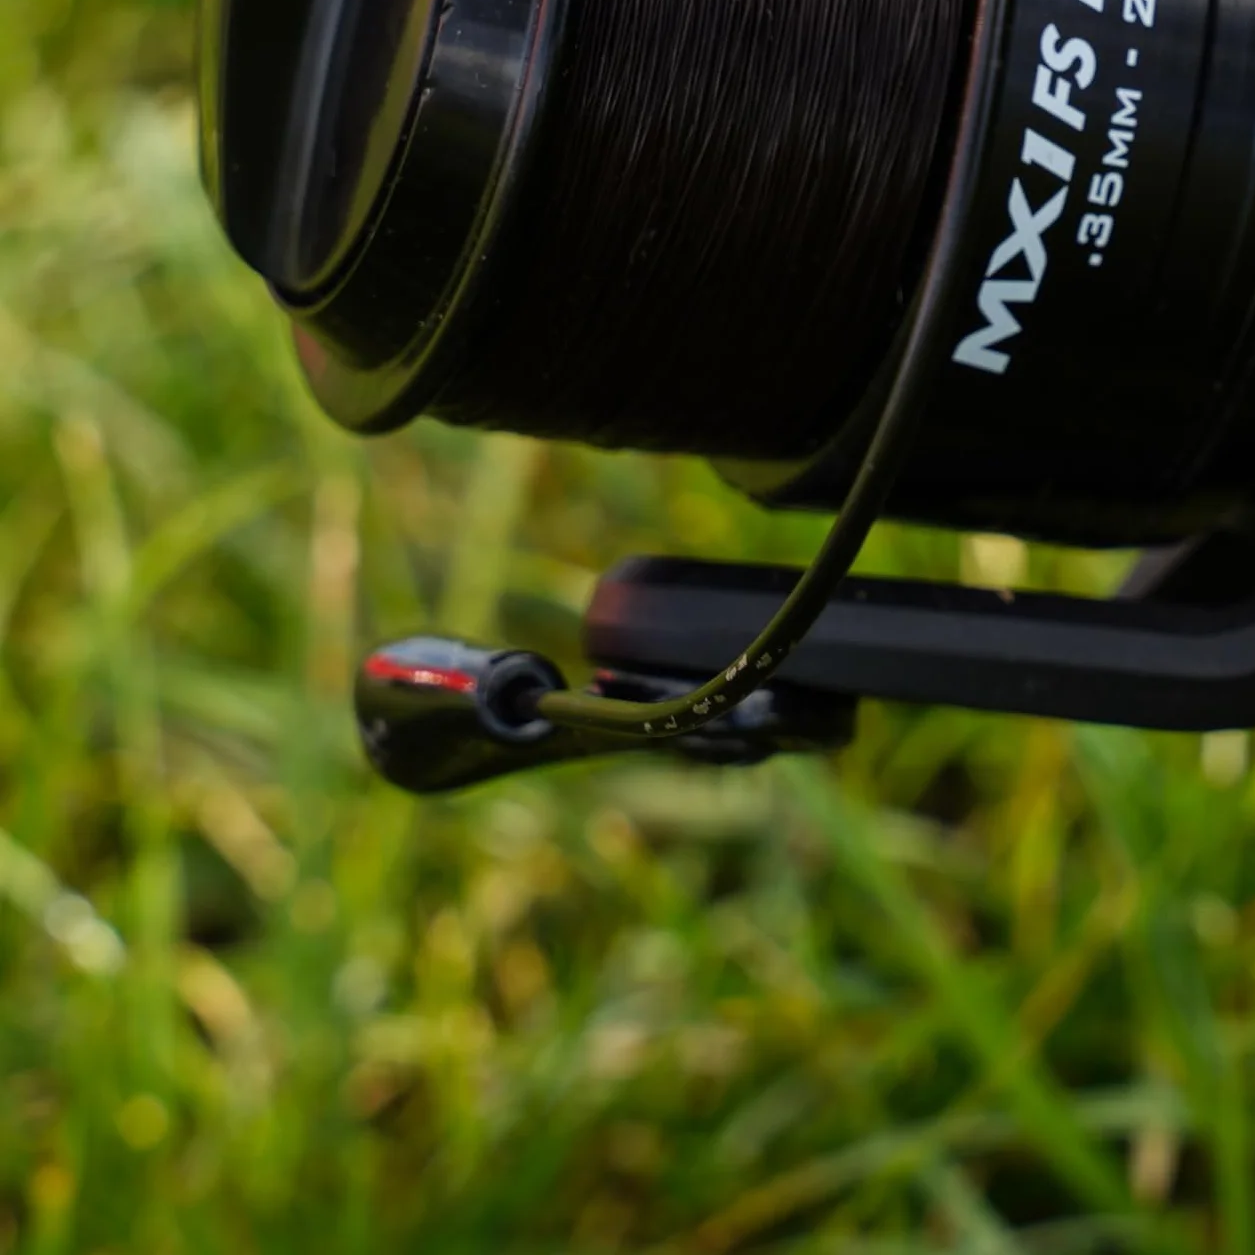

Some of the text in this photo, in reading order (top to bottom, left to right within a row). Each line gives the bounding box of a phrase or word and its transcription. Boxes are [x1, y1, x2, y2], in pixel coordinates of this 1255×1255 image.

[952, 128, 1075, 375] MX1
[1031, 22, 1097, 132] FS
[1077, 86, 1143, 267] .35MM
[1125, 47, 1139, 68] -
